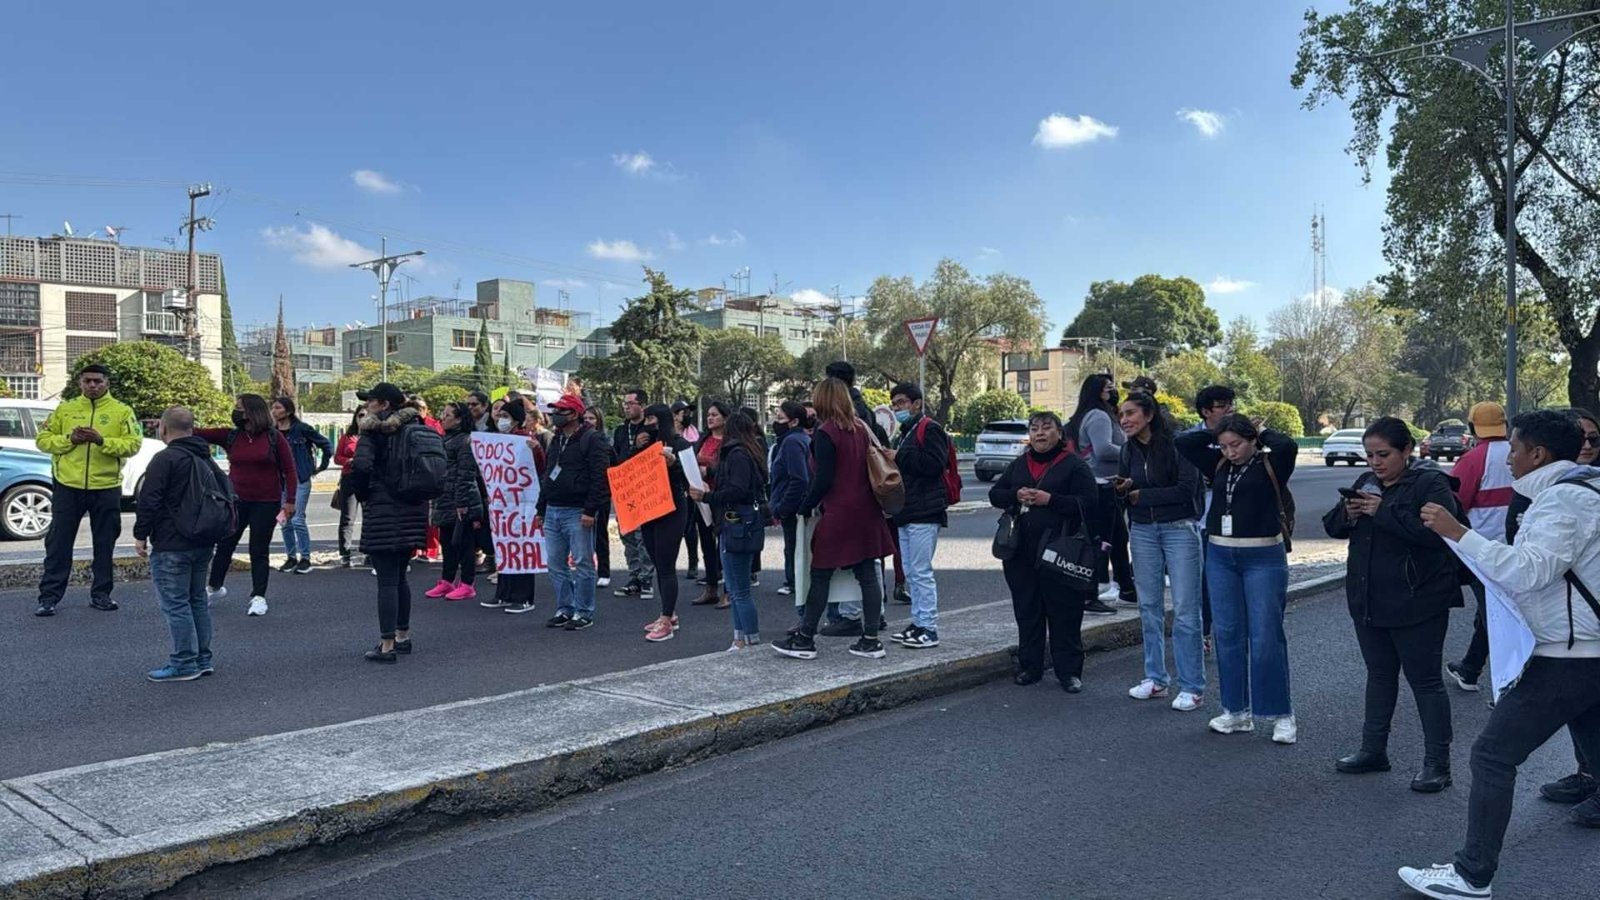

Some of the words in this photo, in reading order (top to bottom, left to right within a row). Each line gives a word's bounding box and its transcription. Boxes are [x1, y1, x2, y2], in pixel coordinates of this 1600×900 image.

[472, 440, 516, 465] TODOS
[479, 463, 532, 488] OMOS
[487, 484, 524, 507] AT
